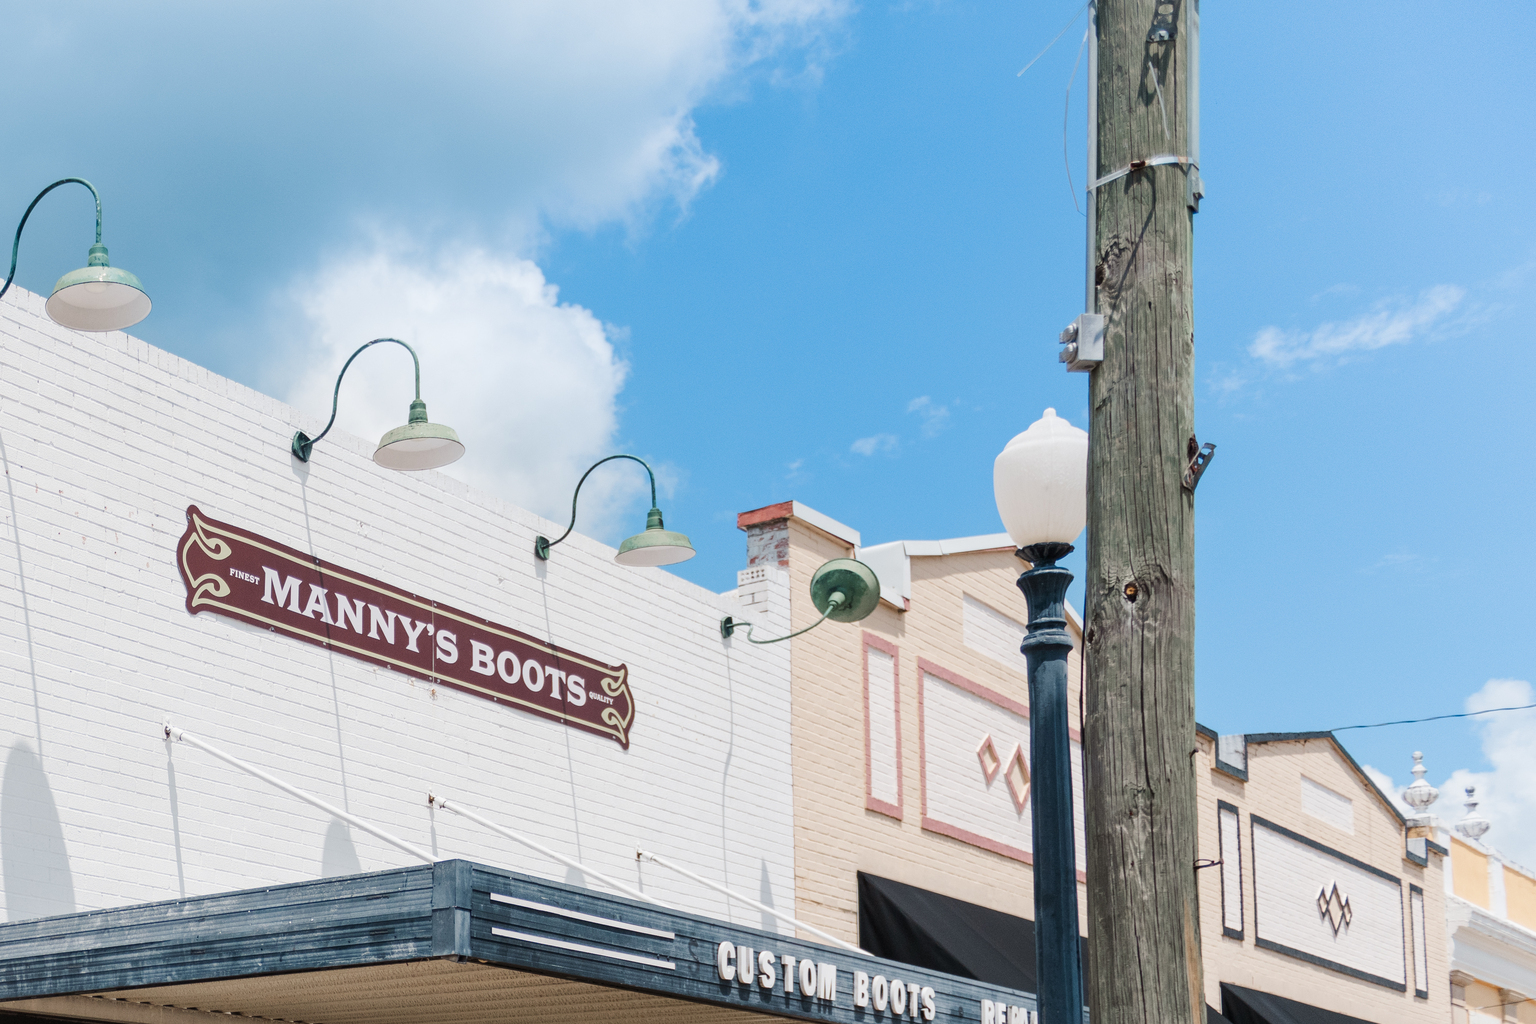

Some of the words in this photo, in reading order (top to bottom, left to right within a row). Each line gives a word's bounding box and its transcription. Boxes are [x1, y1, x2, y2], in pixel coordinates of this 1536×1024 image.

[229, 567, 260, 585] FINEST
[261, 566, 459, 664] MANNY'S
[470, 638, 587, 707] BOOTS
[589, 691, 614, 706] QUALITY
[717, 941, 837, 1001] CUSTOM
[853, 970, 936, 1021] BOOTS
